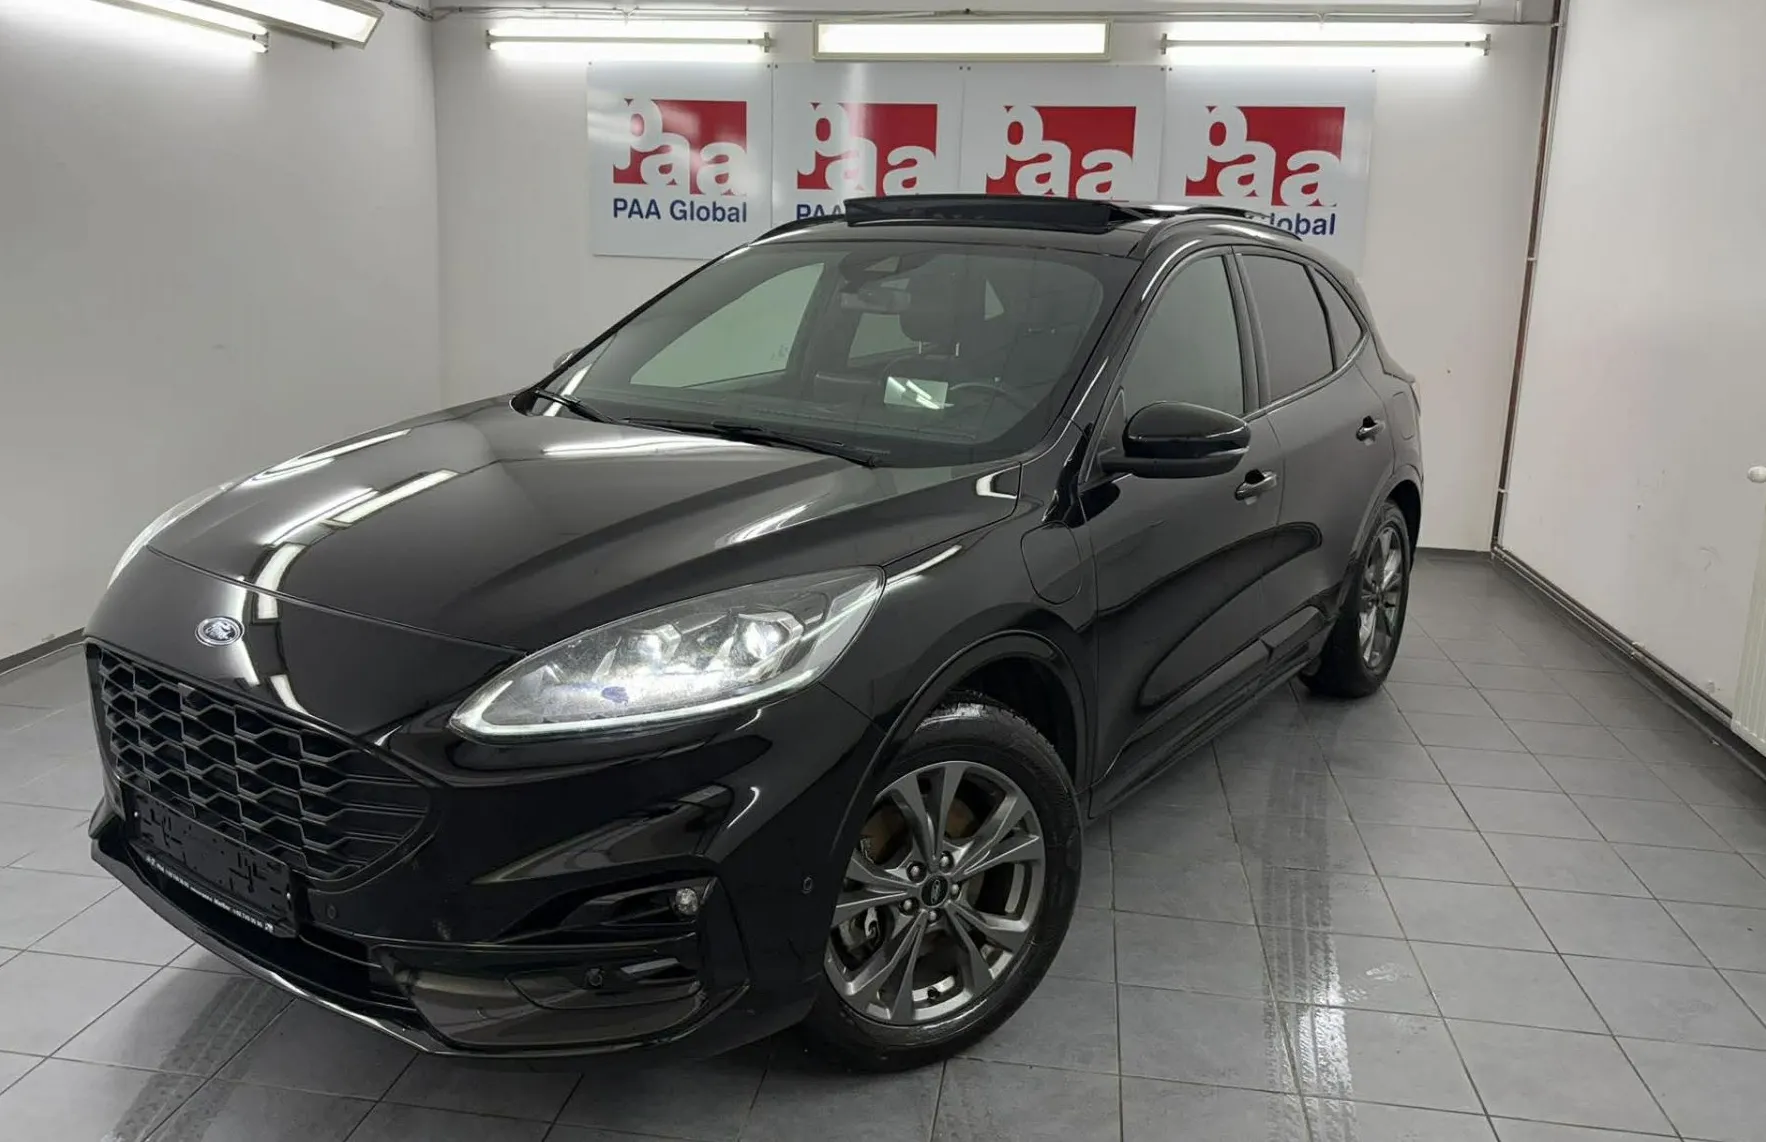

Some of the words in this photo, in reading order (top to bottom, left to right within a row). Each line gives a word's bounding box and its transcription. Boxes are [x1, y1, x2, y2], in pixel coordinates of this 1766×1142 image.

[613, 197, 661, 219] PAA
[669, 199, 747, 222] Global
[1269, 212, 1336, 235] lobal
